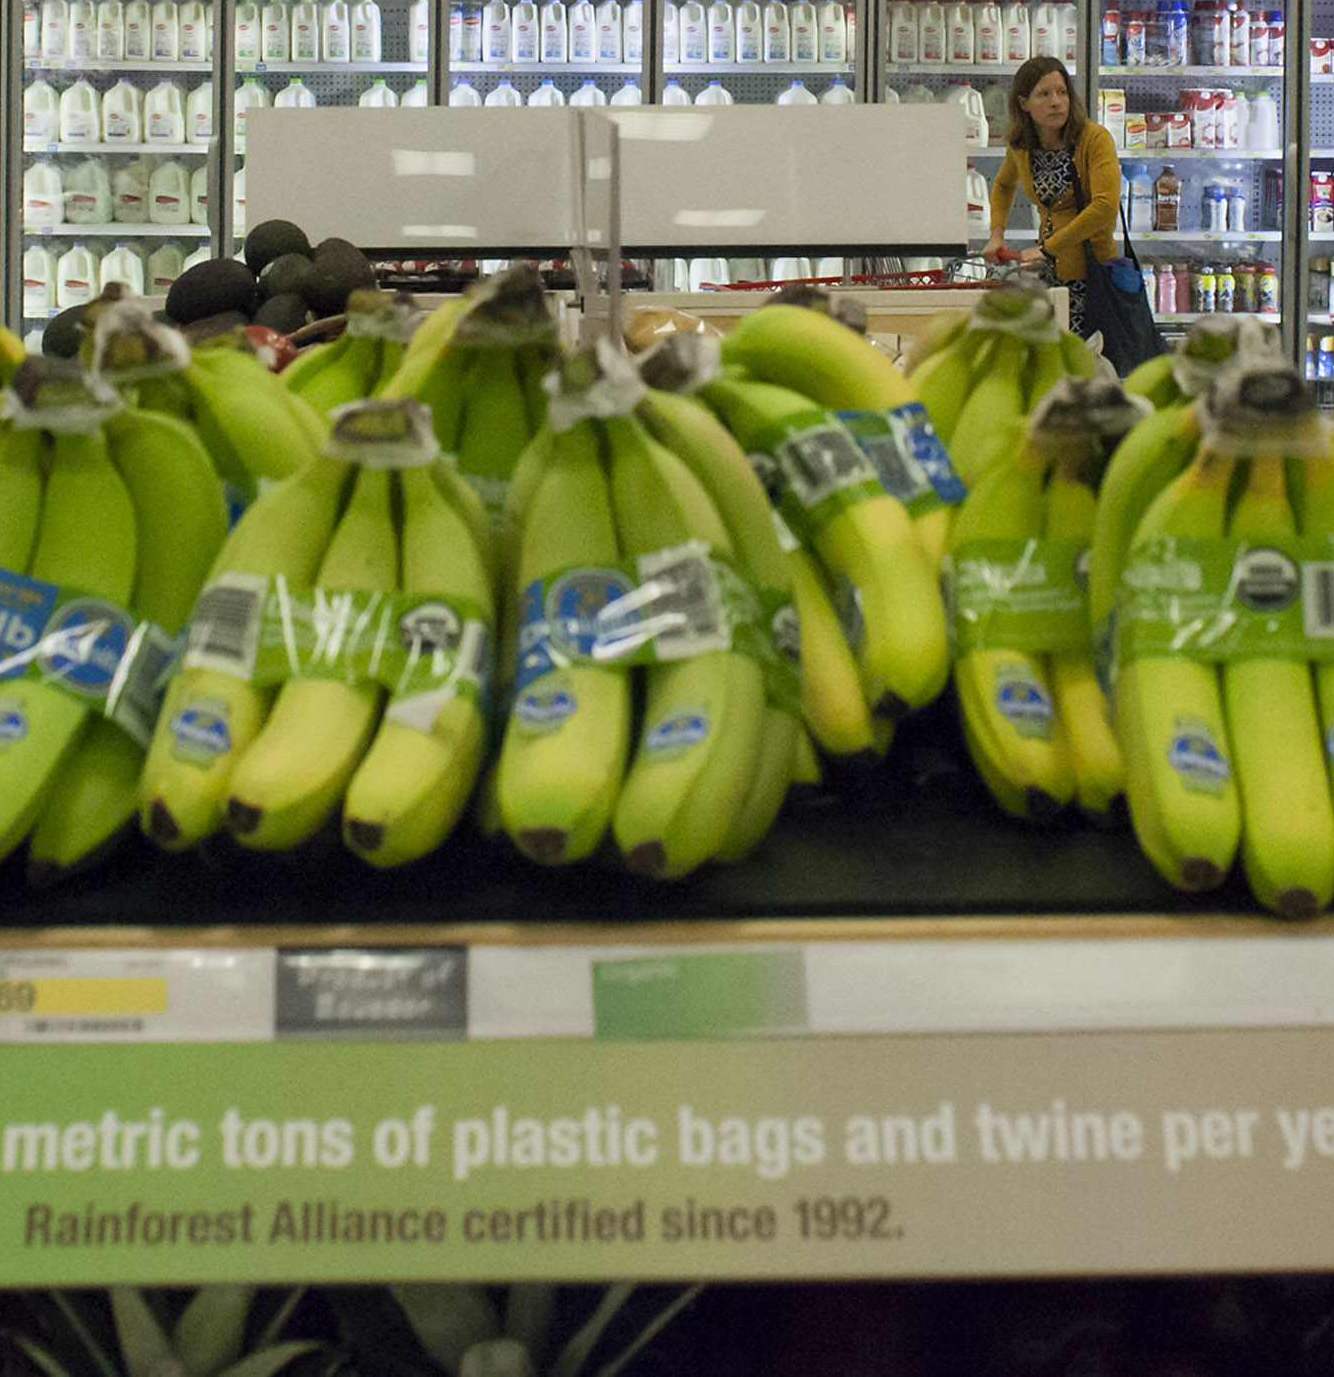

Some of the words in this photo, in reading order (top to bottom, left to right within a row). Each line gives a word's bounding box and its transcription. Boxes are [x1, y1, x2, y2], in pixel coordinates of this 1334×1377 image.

[1, 1106, 200, 1171] metric
[221, 1108, 355, 1168] tons
[373, 1105, 436, 1167] of
[453, 1104, 660, 1180] plastic
[677, 1104, 826, 1179] bags
[845, 1102, 958, 1165] and
[975, 1100, 1144, 1162] twine
[1161, 1106, 1259, 1172] per
[24, 1200, 254, 1248] Rainforest
[268, 1198, 447, 1245] Alliance
[465, 1197, 647, 1243] certified
[665, 1196, 777, 1242] since
[793, 1196, 905, 1241] 1992.
